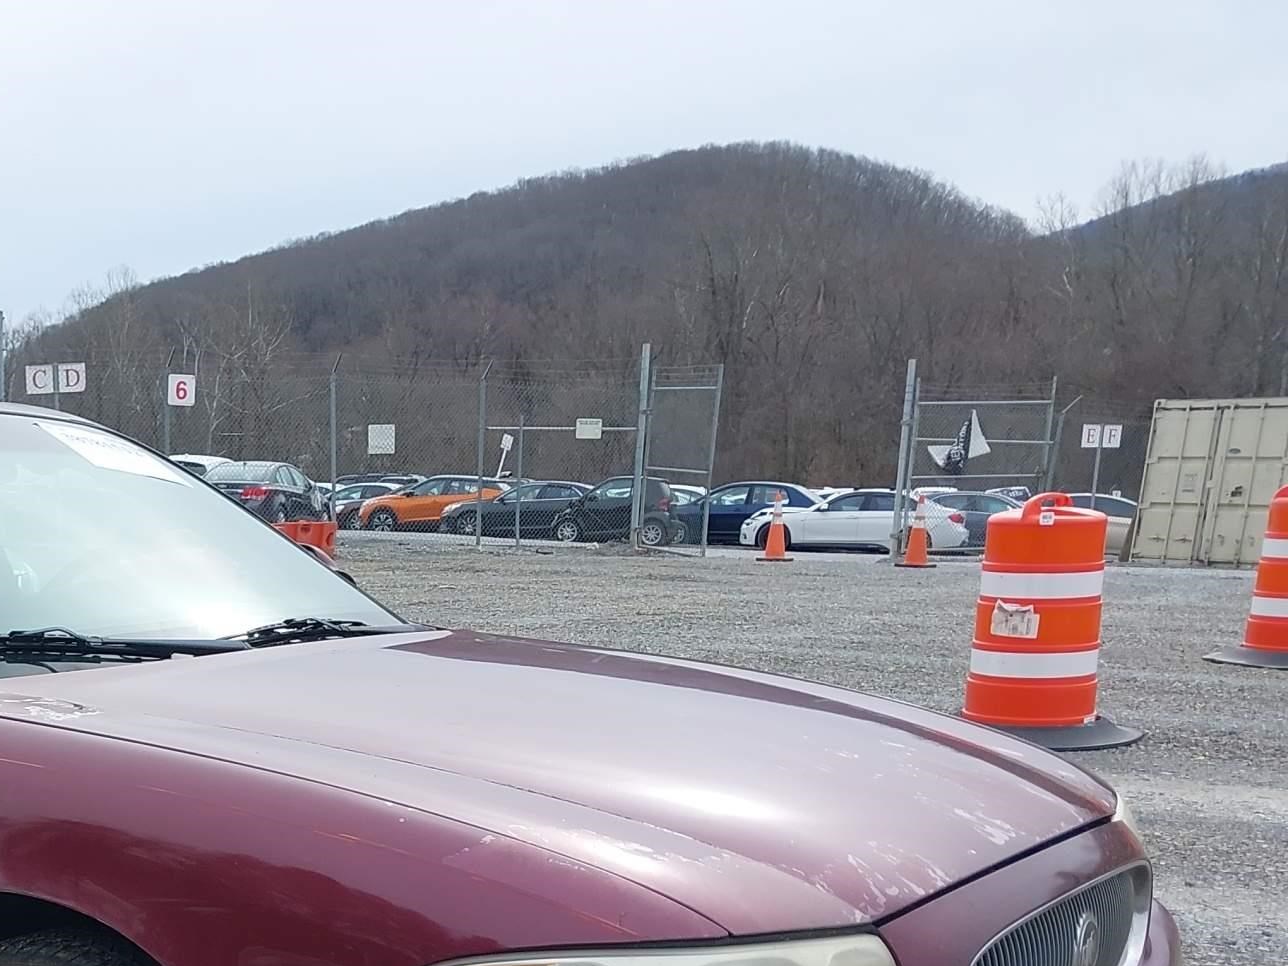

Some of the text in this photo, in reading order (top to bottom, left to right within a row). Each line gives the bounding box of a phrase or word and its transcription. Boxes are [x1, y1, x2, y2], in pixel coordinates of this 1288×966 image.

[32, 369, 48, 389] C
[64, 368, 80, 387] D
[175, 380, 188, 400] 6
[1087, 428, 1096, 443] E
[1108, 428, 1117, 443] F
